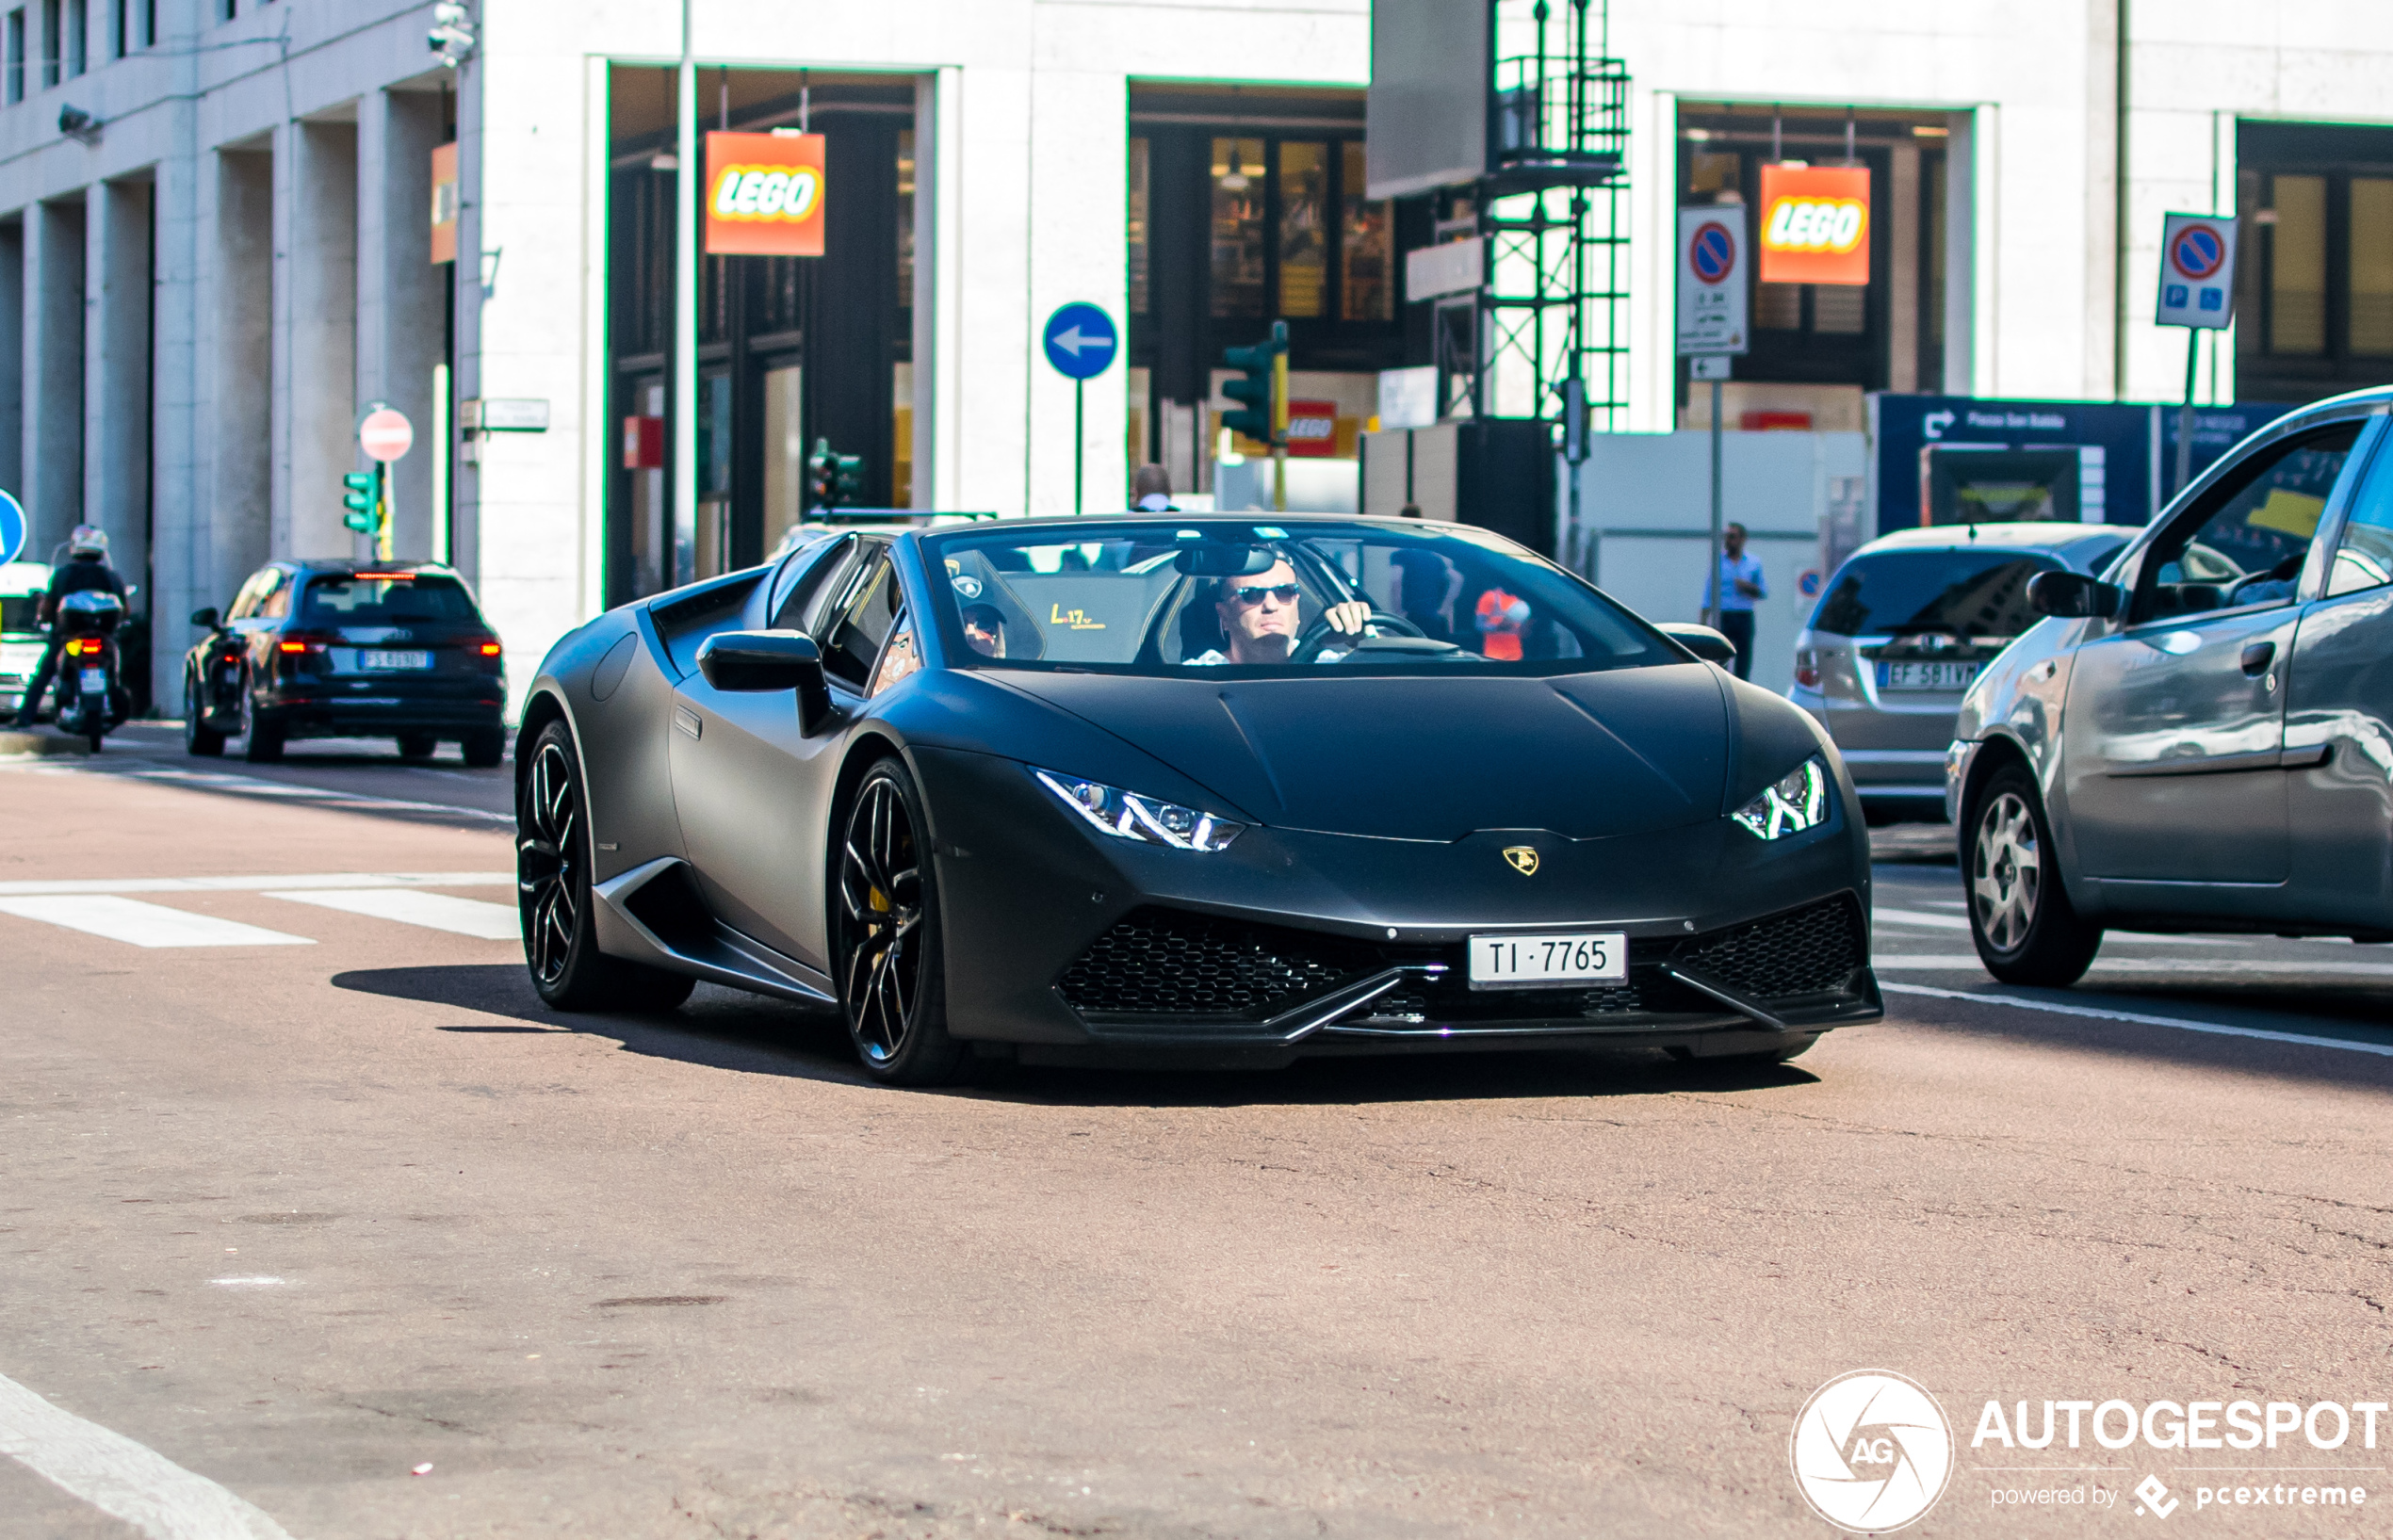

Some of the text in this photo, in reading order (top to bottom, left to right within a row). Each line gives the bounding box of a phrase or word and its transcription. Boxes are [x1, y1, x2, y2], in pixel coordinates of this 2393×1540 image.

[716, 170, 816, 215] LEGO
[1769, 202, 1862, 246] LEGO
[1288, 418, 1332, 438] LEGO
[1891, 663, 1910, 685] EF
